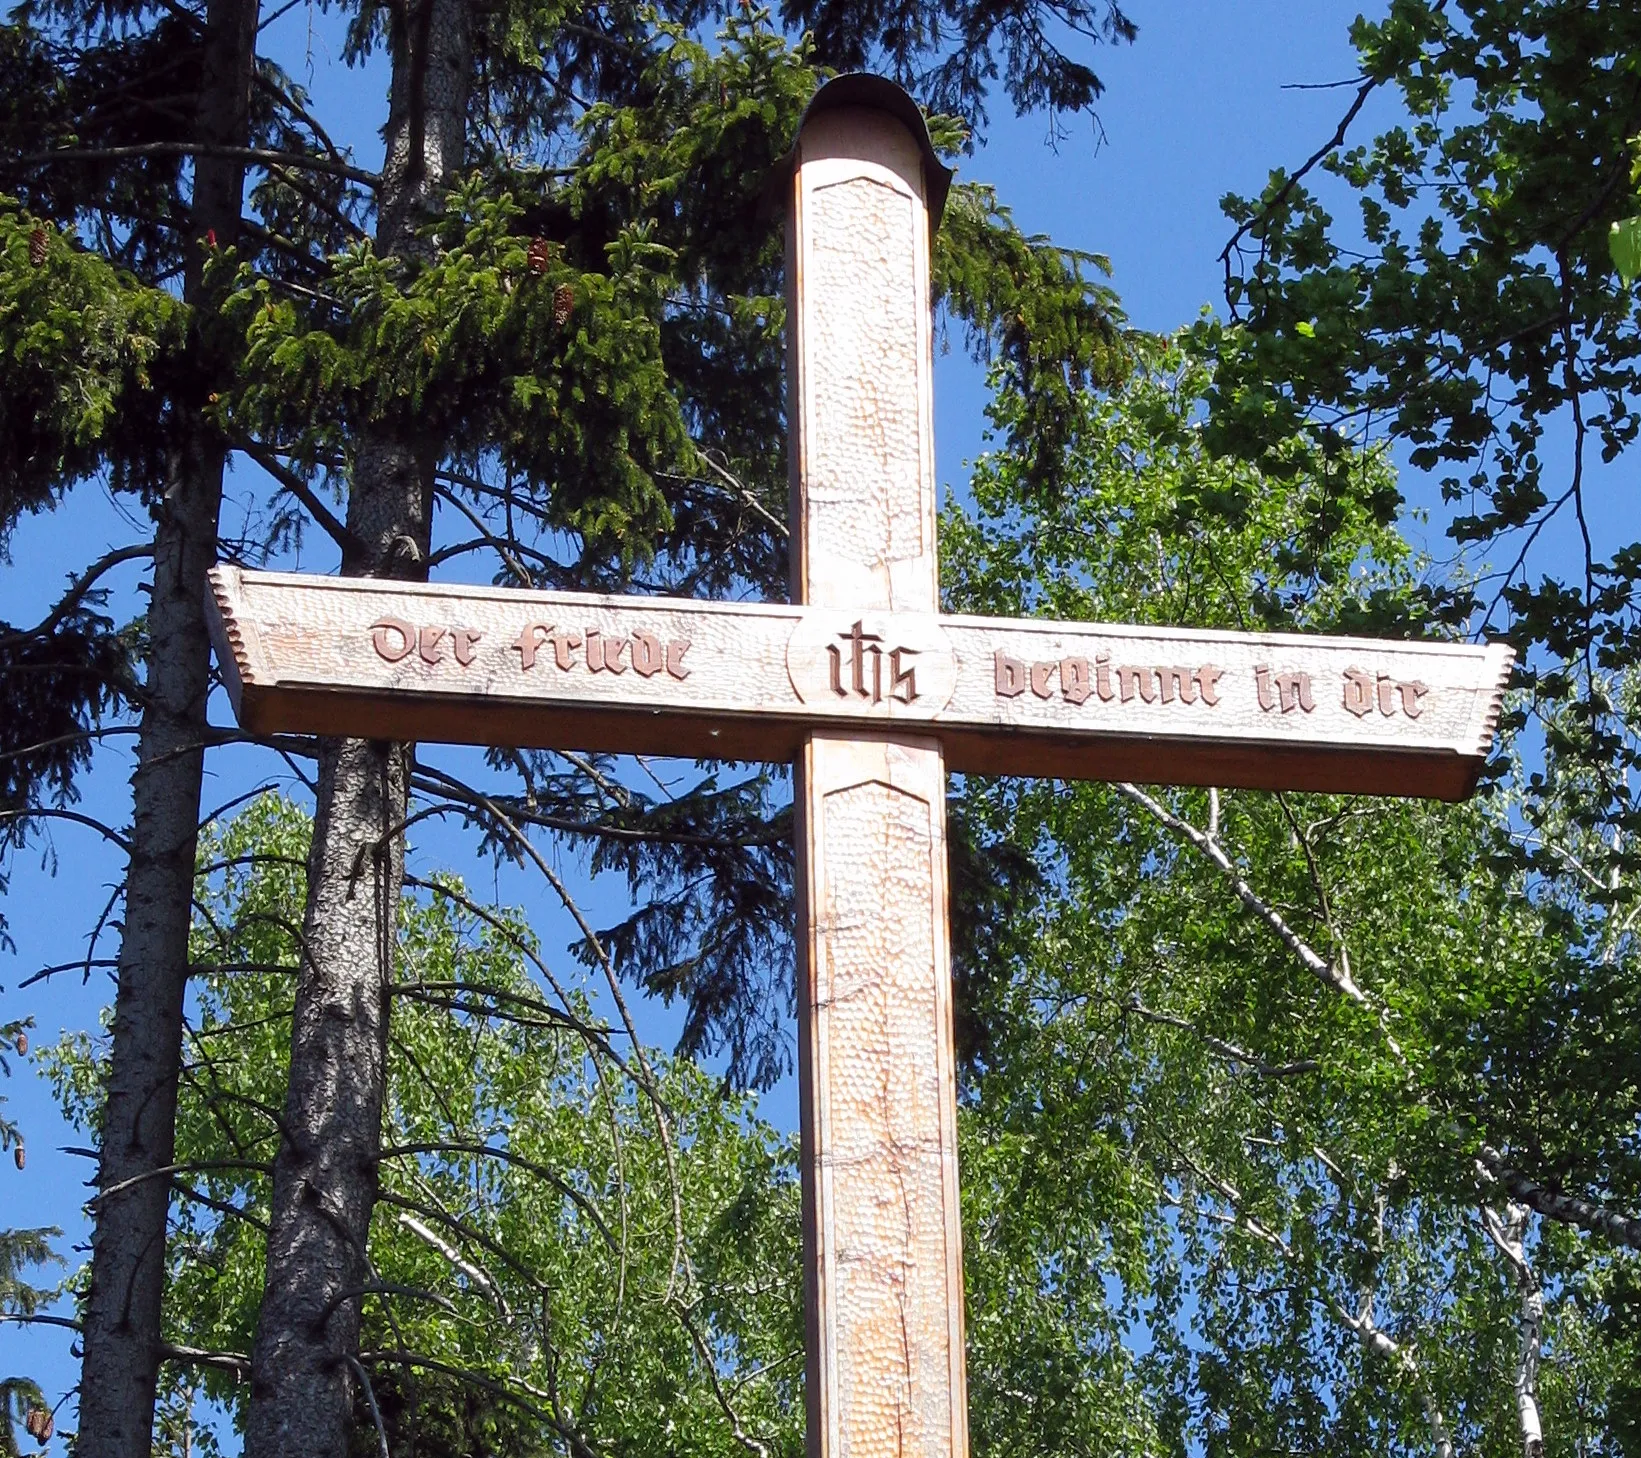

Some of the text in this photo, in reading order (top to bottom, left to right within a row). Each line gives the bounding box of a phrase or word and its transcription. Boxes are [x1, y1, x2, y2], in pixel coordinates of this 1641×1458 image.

[368, 616, 482, 667] Der
[993, 647, 1430, 720] beginnt in dir
